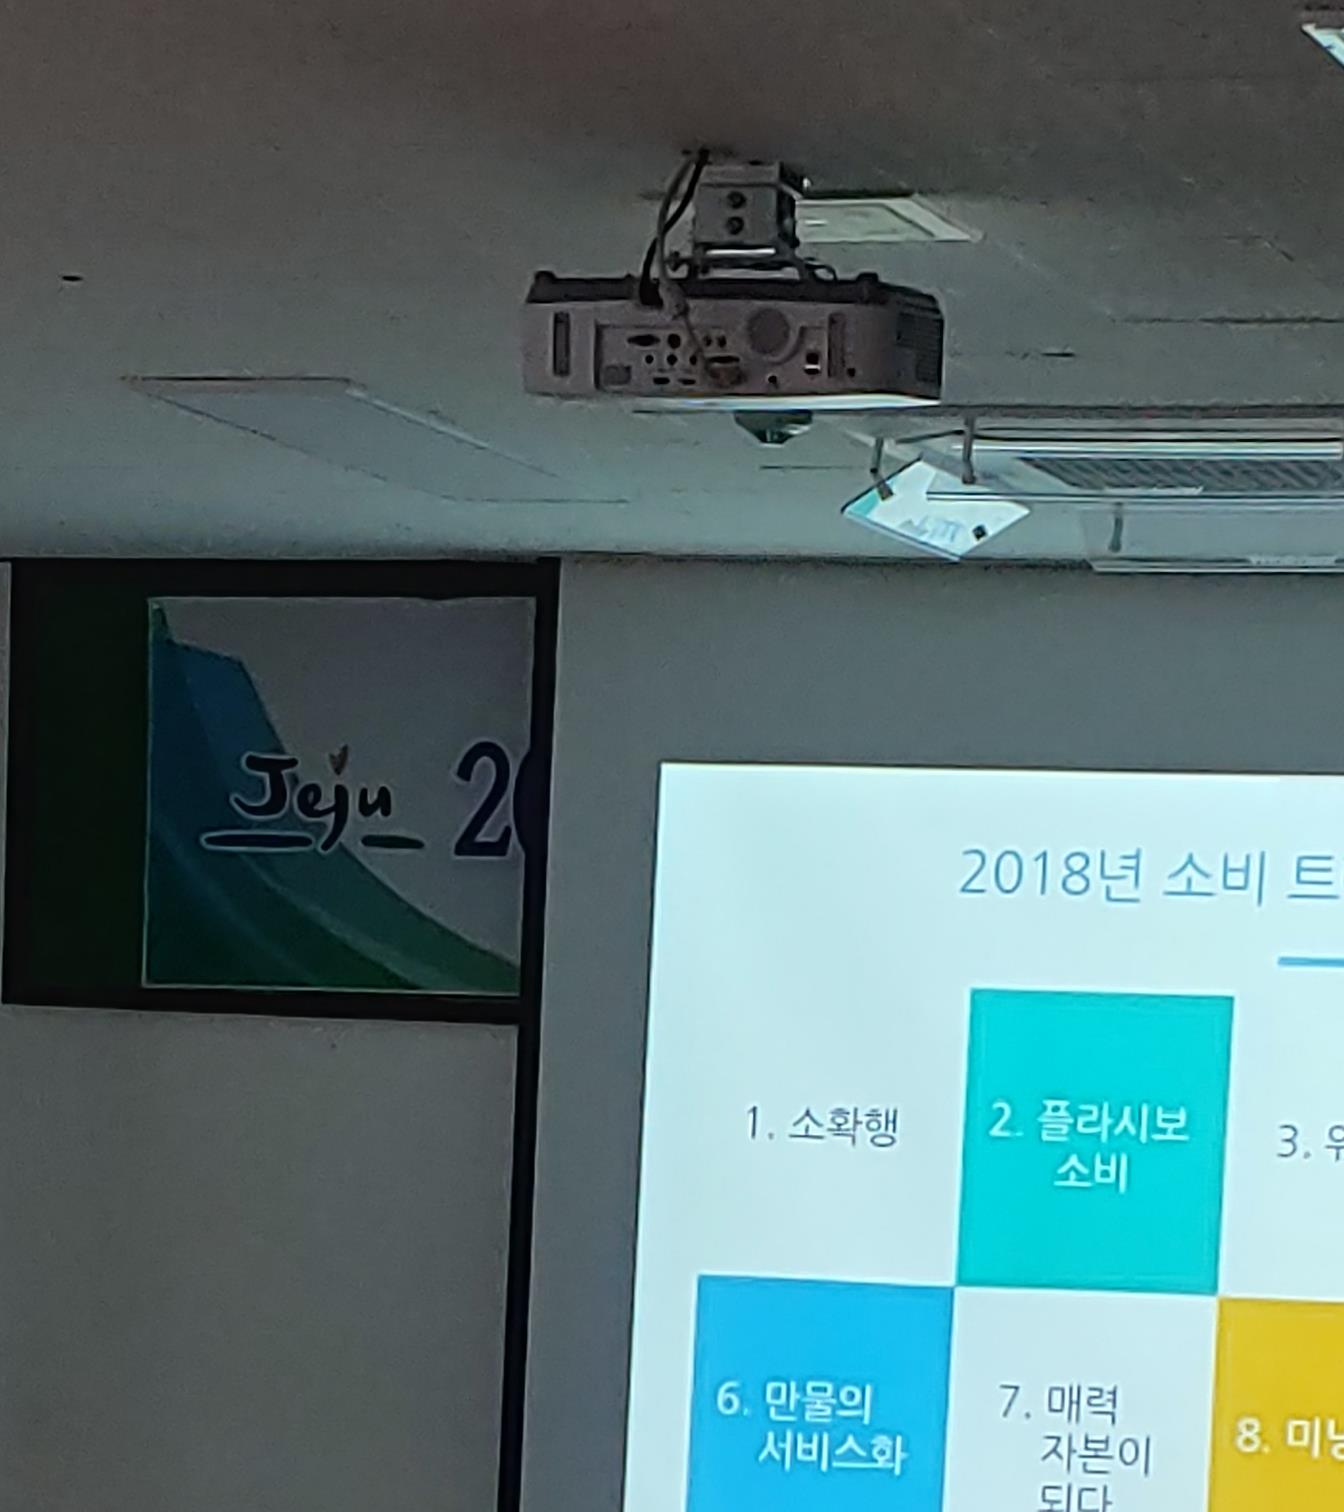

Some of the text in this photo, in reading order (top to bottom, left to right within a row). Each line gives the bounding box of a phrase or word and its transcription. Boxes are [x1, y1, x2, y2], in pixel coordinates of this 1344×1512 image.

[230, 745, 393, 852] Jeju
[959, 847, 1145, 904] 2018년
[1162, 850, 1266, 907] 소비
[747, 1105, 899, 1148] 1. 소확행
[988, 1096, 1190, 1144] 2. 플라시보
[1276, 1124, 1311, 1160] 3.
[1053, 1152, 1128, 1194] 소비
[716, 1379, 873, 1425] 6. 만물의
[999, 1384, 1118, 1427] 7. 매력
[758, 1428, 908, 1476] 서비스화
[1041, 1432, 1151, 1477] 자본이
[1235, 1417, 1270, 1453] 8.
